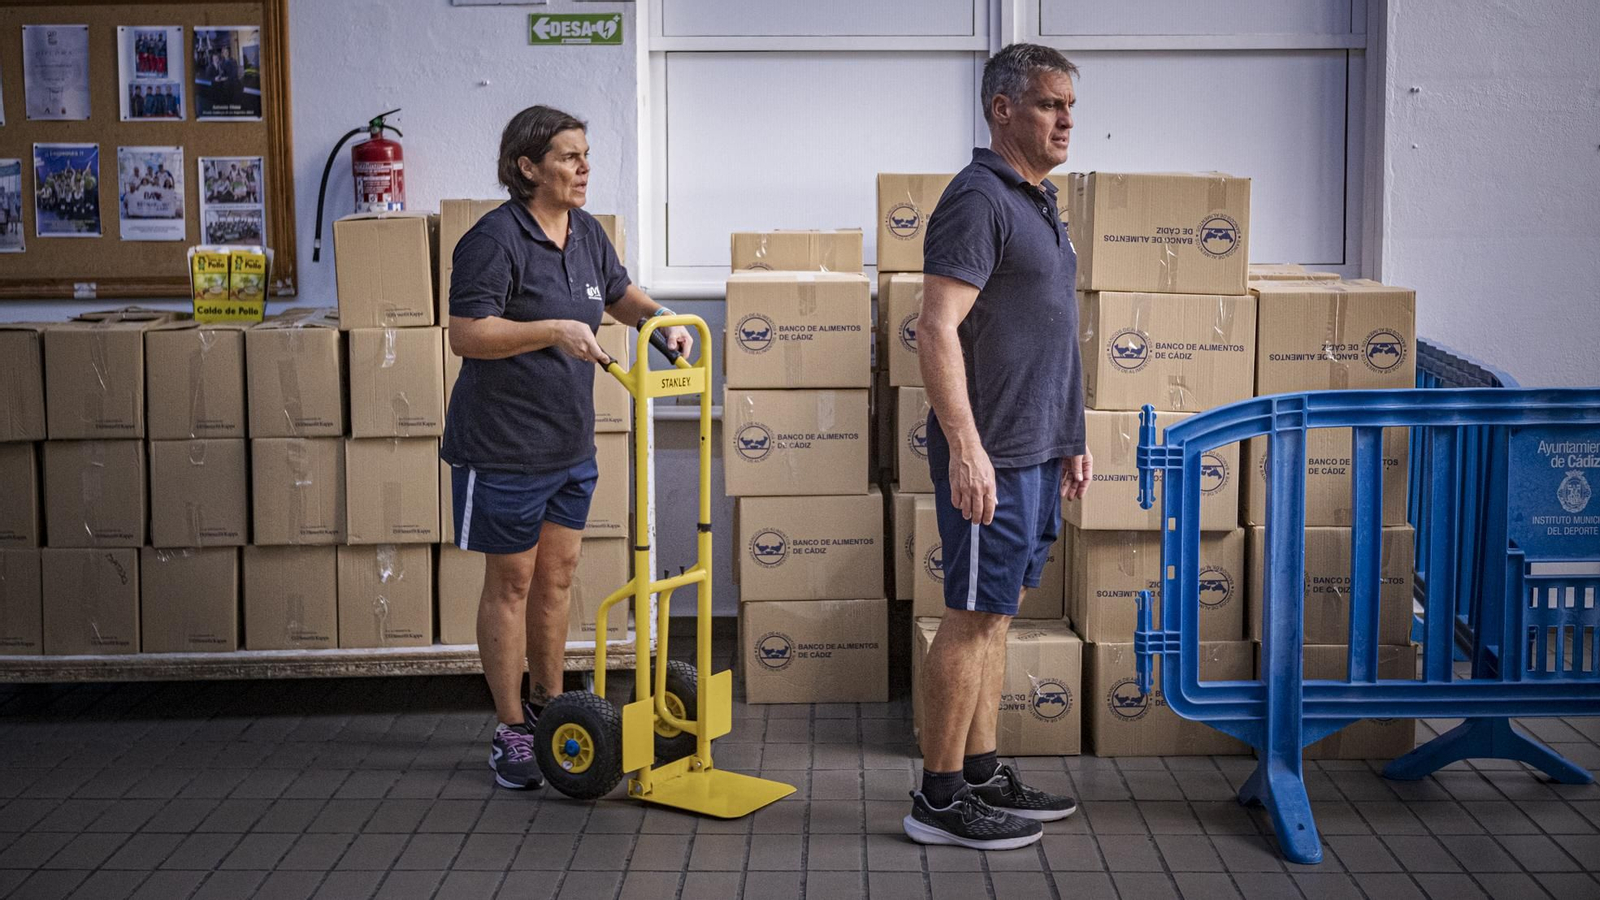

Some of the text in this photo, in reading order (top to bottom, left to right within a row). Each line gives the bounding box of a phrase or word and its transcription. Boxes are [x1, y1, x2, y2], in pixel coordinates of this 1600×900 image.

[550, 21, 593, 37] DESA
[1157, 227, 1180, 236] CÁDIZ
[1104, 235, 1149, 243] ALIMENTOS
[197, 306, 222, 315] Caldo
[239, 307, 259, 315] Pollo
[1198, 344, 1244, 352] ALIMENTOS
[1168, 351, 1192, 359] CÁDIZ
[662, 377, 691, 388] STANLEY
[1551, 454, 1600, 468] de Cádiz
[1322, 466, 1346, 474] CÁDIZ
[1532, 516, 1571, 524] INSTITUTO
[1547, 527, 1598, 535] DEL DEPORTE
